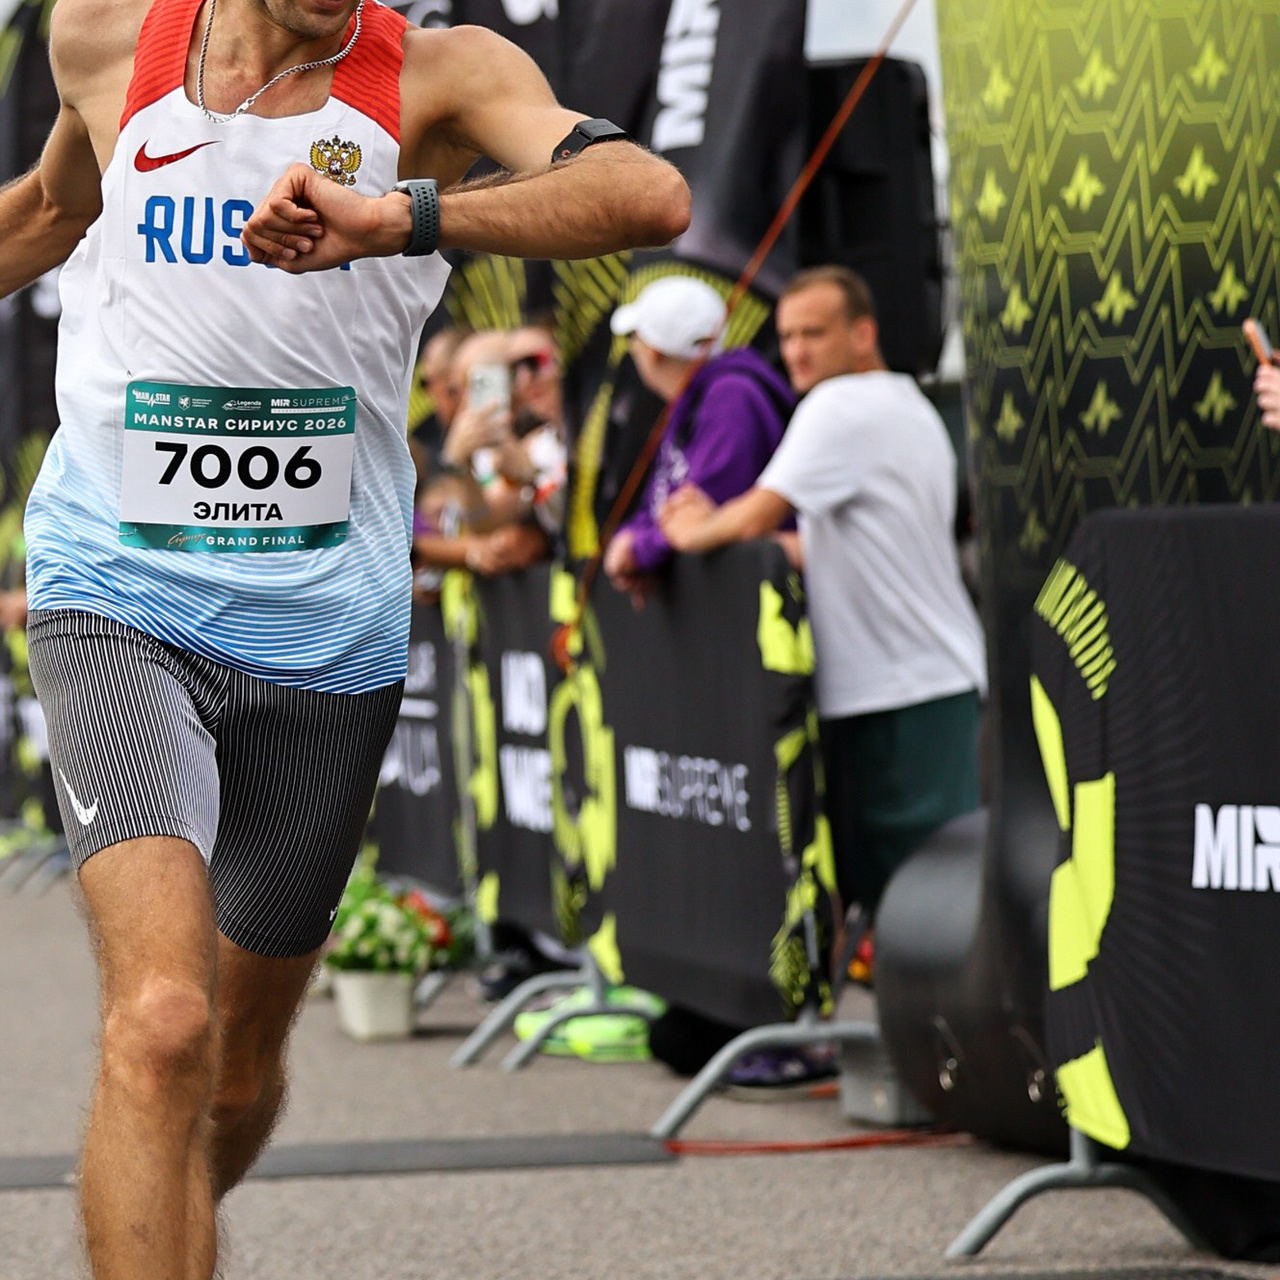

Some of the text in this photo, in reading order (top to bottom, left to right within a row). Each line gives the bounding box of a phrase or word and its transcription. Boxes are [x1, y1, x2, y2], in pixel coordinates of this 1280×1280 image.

[270, 396, 347, 407] MIR SUPREME
[133, 412, 347, 432] MANSTAR СИРИУС 2026
[154, 440, 323, 491] 7006
[193, 501, 284, 522] ЭЛИТА
[206, 534, 305, 546] GRAND FINAL
[1191, 803, 1280, 893] MIR
